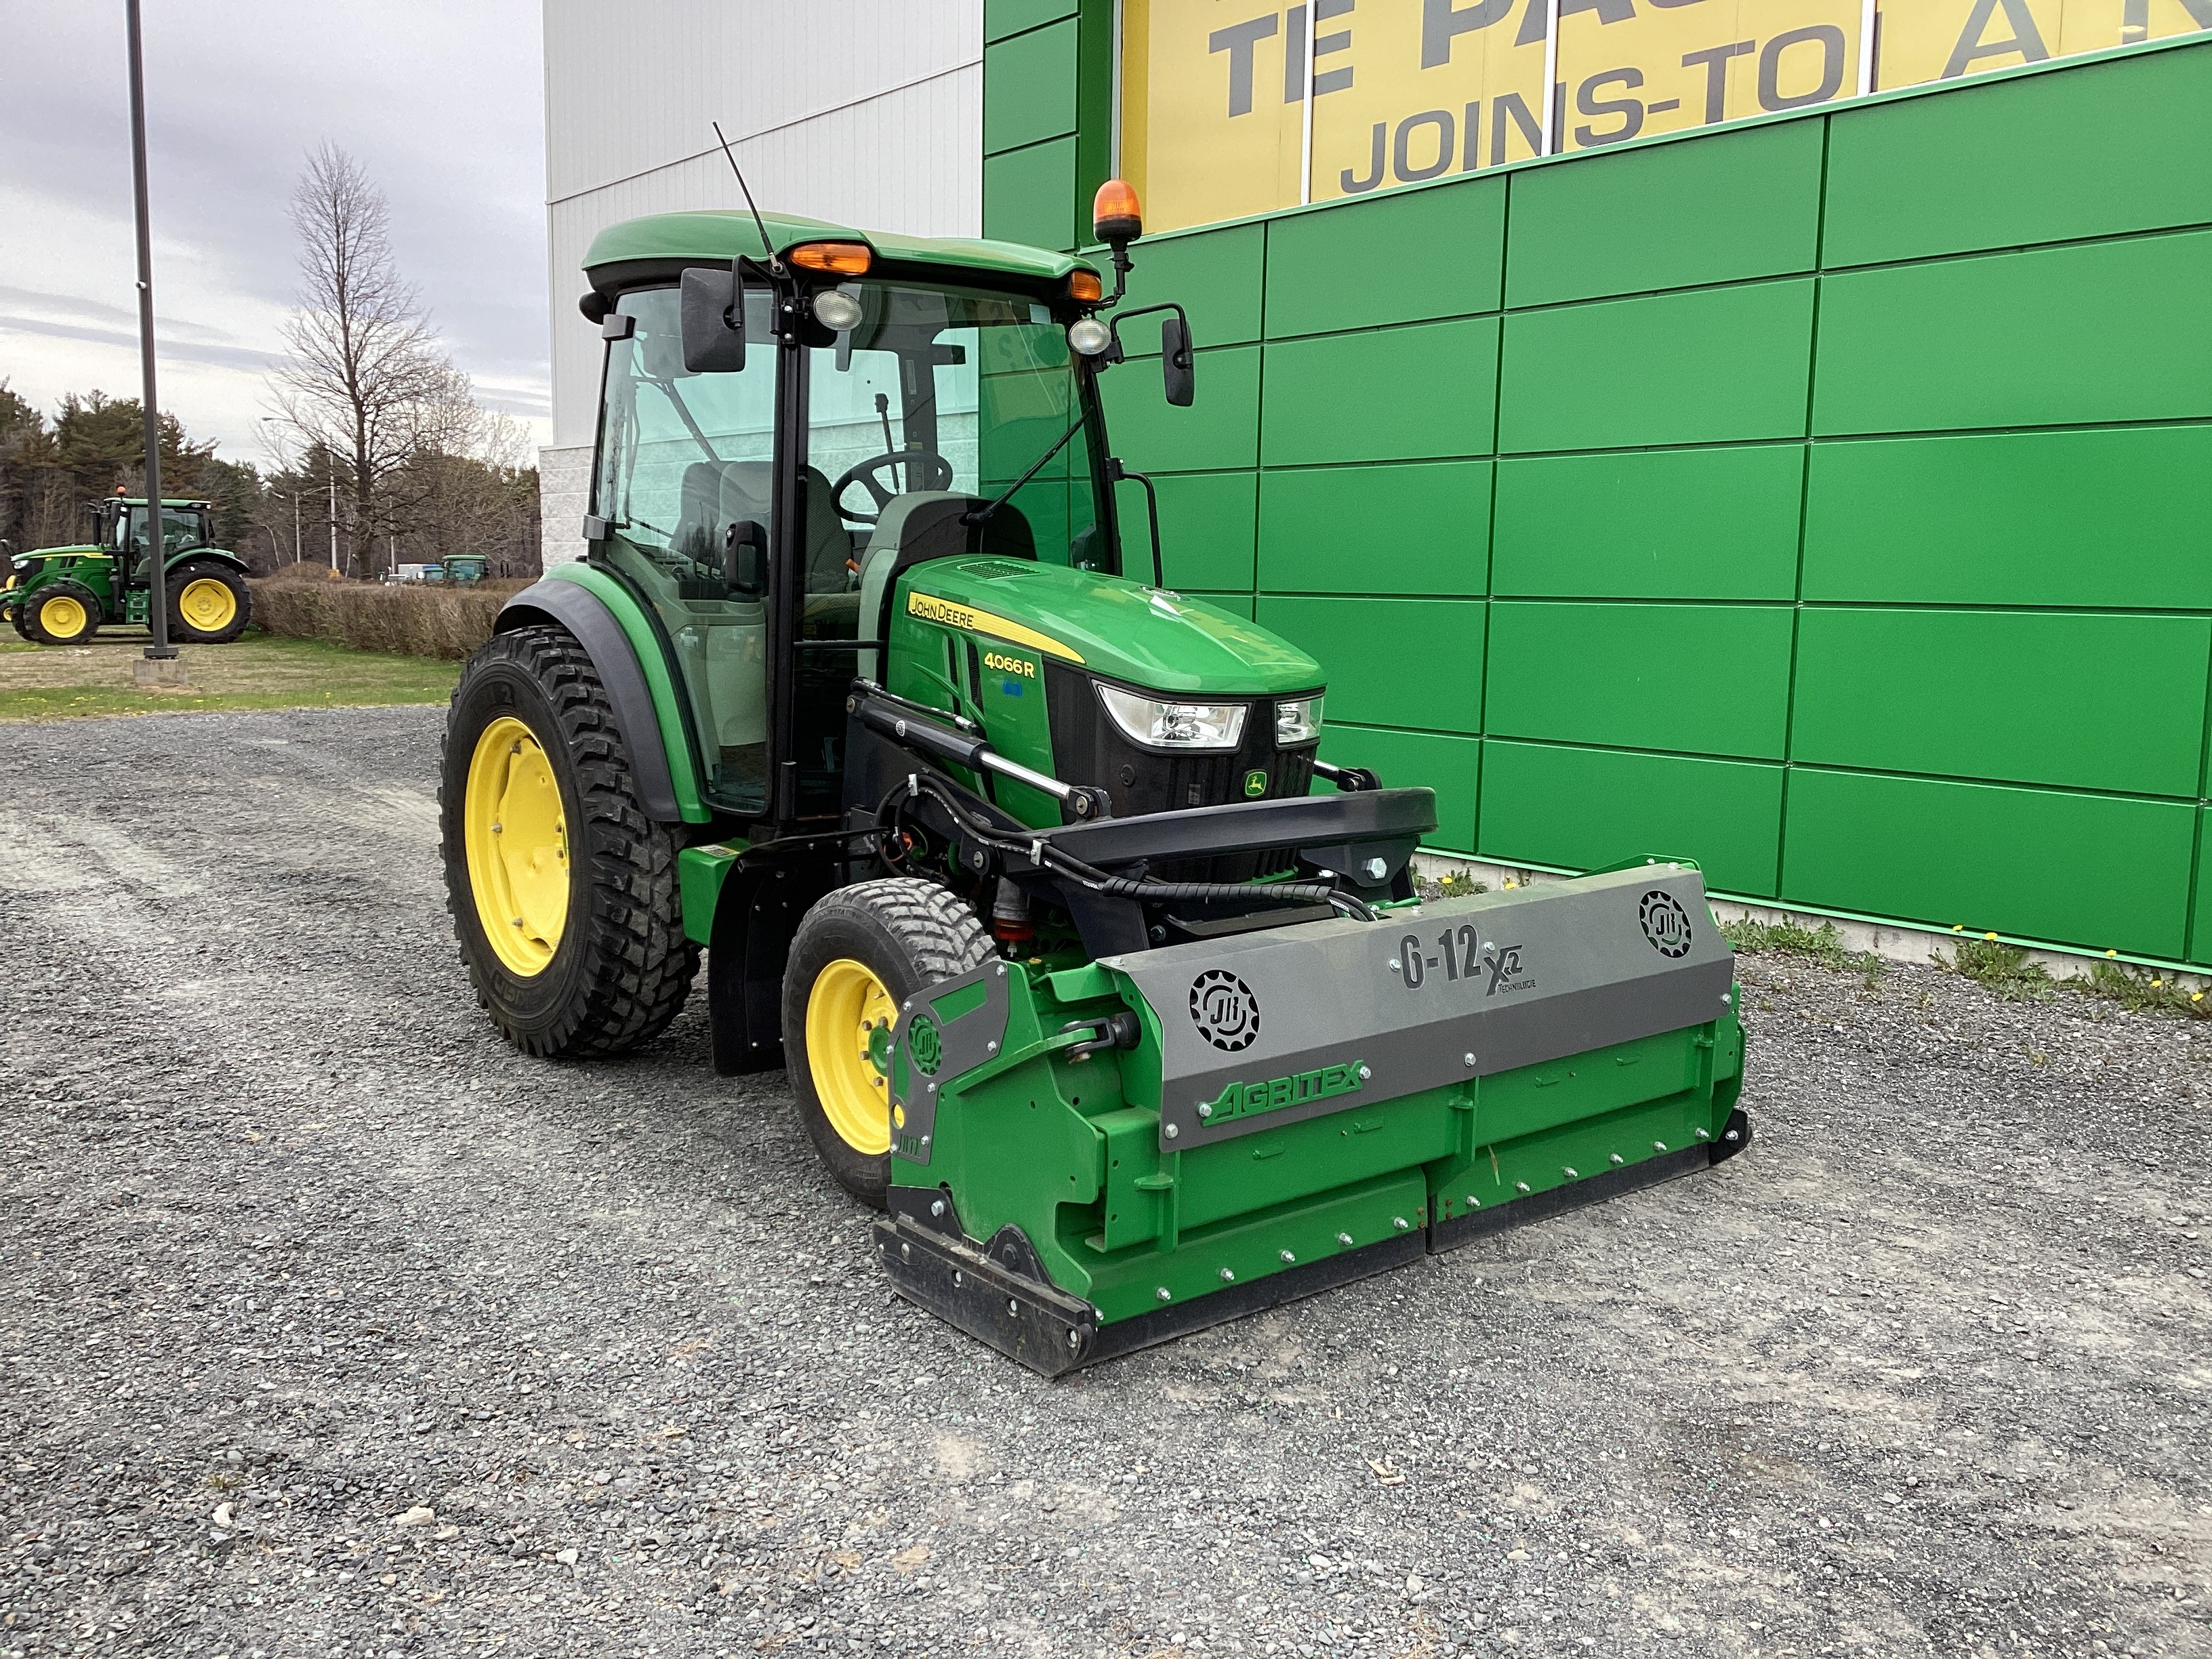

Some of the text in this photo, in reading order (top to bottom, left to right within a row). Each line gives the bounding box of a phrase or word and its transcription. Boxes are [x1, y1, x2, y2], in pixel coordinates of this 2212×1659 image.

[910, 597, 974, 628] JOHN DEERE
[1400, 924, 1482, 990] 6-12
[1203, 1059, 1364, 1127] AGRITEX
